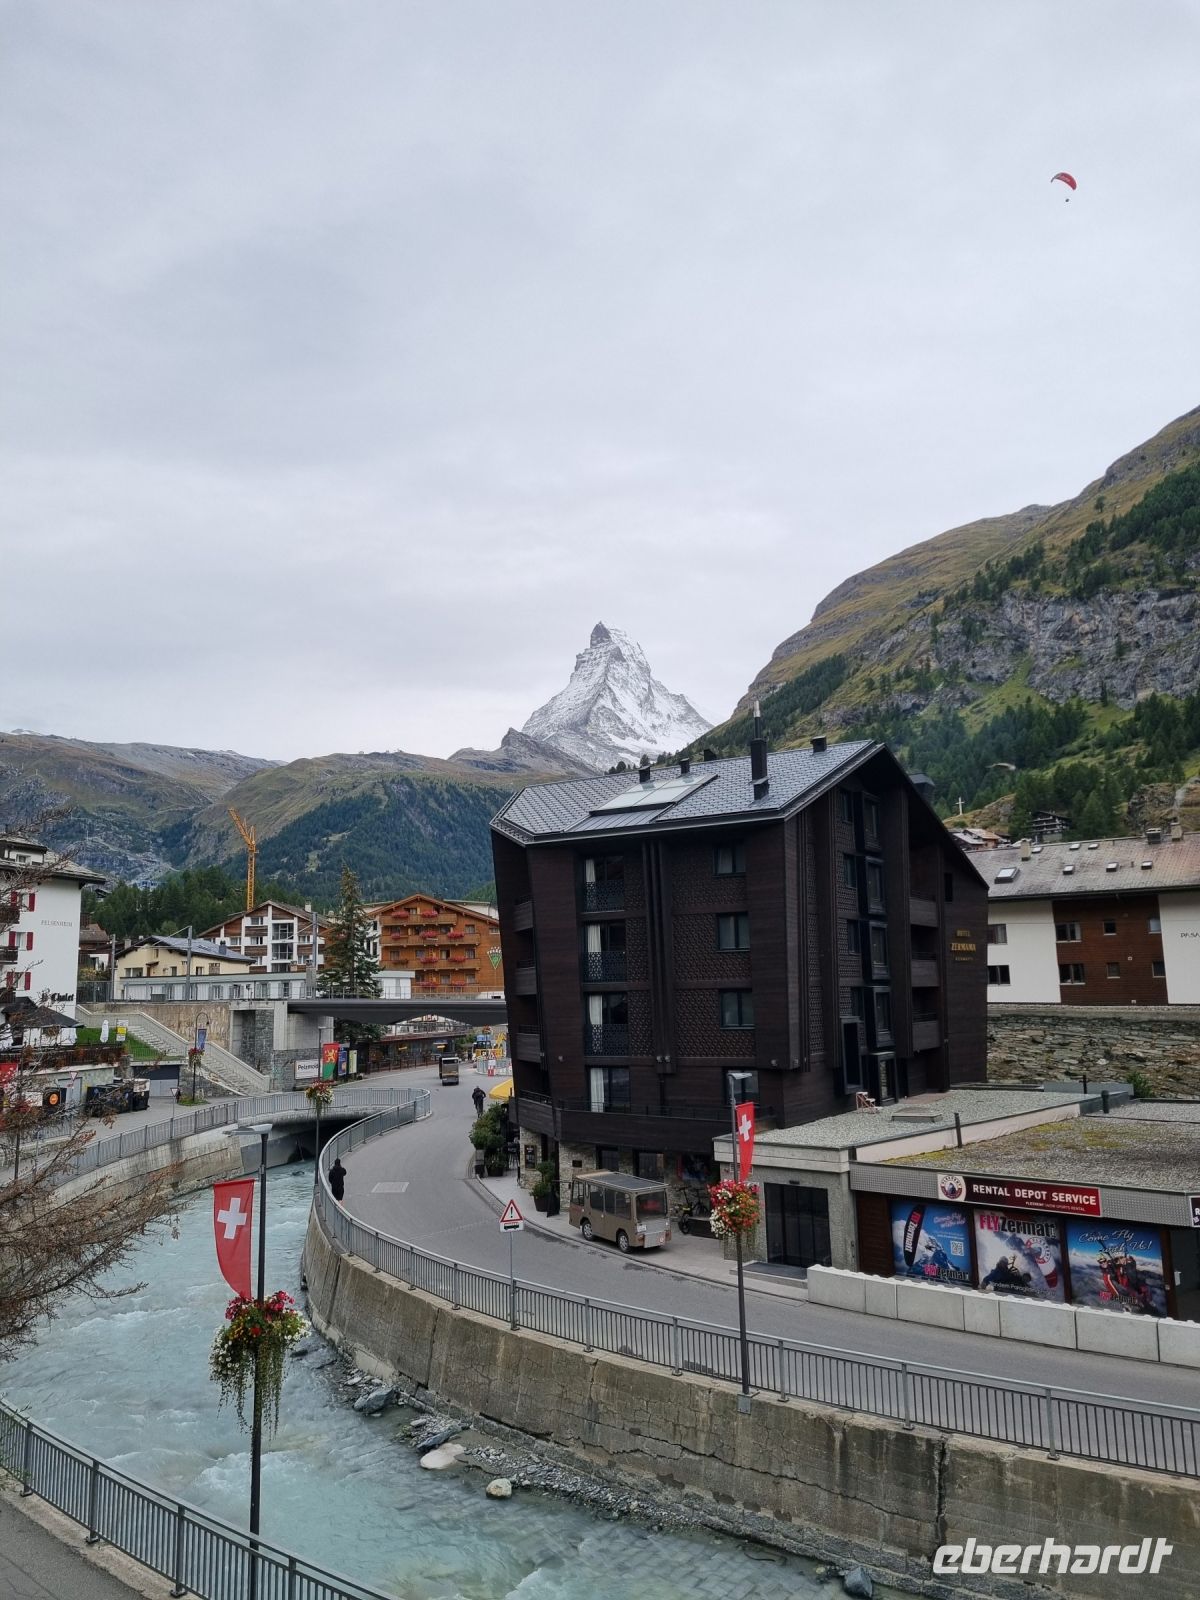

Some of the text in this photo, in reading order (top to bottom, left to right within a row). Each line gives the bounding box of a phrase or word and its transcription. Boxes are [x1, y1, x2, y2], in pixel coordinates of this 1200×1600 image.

[972, 1184, 1011, 1197] RENTAL
[1014, 1188, 1048, 1200] DEPOT
[1051, 1192, 1097, 1206] SERVICE
[1078, 1229, 1135, 1242] Come Fly
